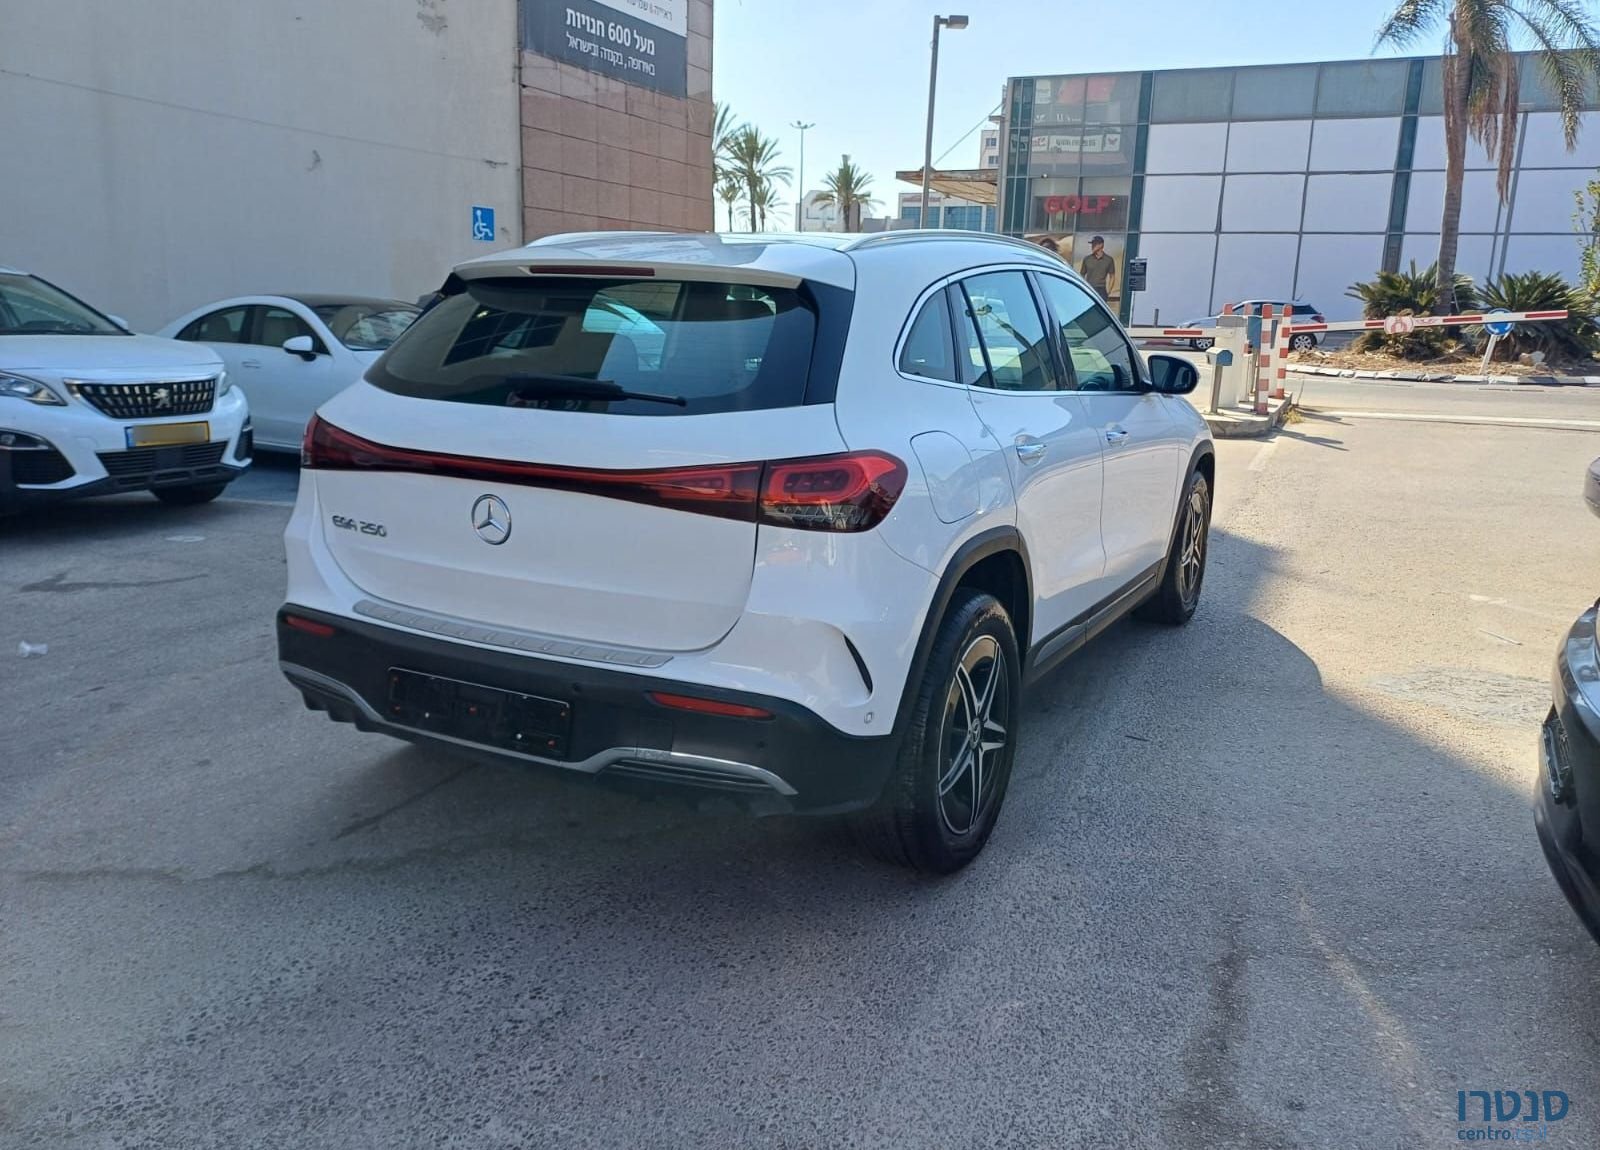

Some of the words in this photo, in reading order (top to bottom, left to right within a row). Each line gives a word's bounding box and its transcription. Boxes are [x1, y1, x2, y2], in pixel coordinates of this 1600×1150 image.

[566, 7, 605, 38] חנויות
[607, 22, 631, 47] 600
[633, 29, 656, 56] מעל
[1044, 194, 1110, 213] GOLF
[359, 520, 387, 538] 250
